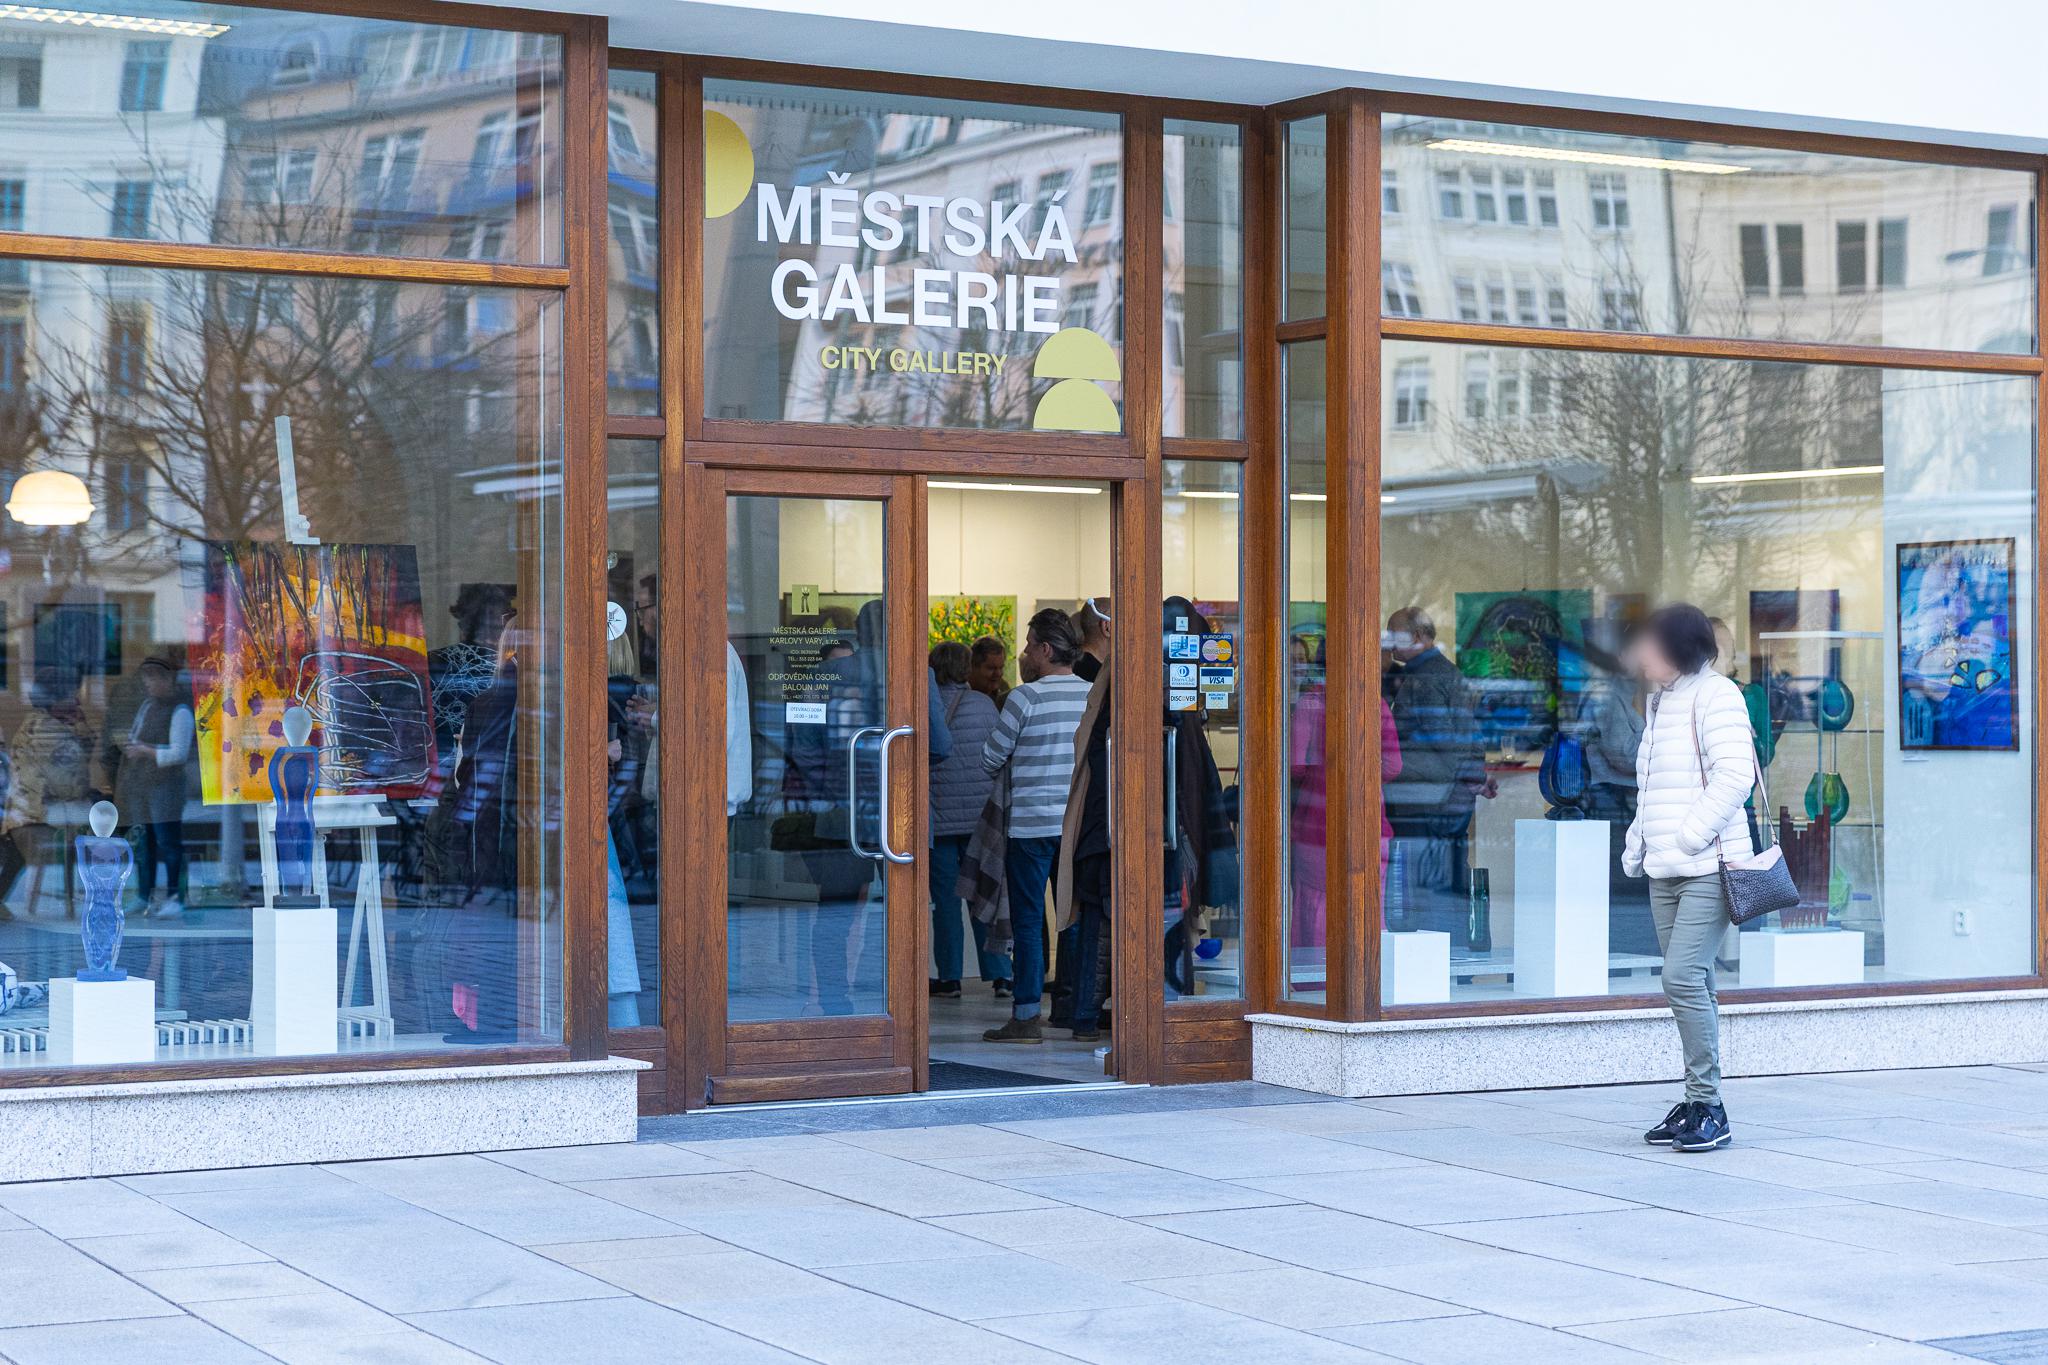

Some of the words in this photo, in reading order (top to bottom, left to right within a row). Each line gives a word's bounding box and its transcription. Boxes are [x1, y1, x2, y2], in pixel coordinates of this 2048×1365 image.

[757, 170, 1079, 263] MĚSTSKÁ
[771, 258, 1061, 334] GALERIE
[820, 345, 882, 371] CITY
[889, 348, 1008, 376] GALLERY
[772, 626, 807, 635] MĚSTSKÁ
[808, 627, 837, 635] GALERIE
[769, 637, 803, 645] KARLOVY
[768, 672, 814, 681] ODPOVĚDNÁ
[815, 673, 842, 681] OSOBA:
[1209, 676, 1225, 684] VISA
[782, 683, 813, 691] BALOUN
[814, 683, 829, 691] JAN
